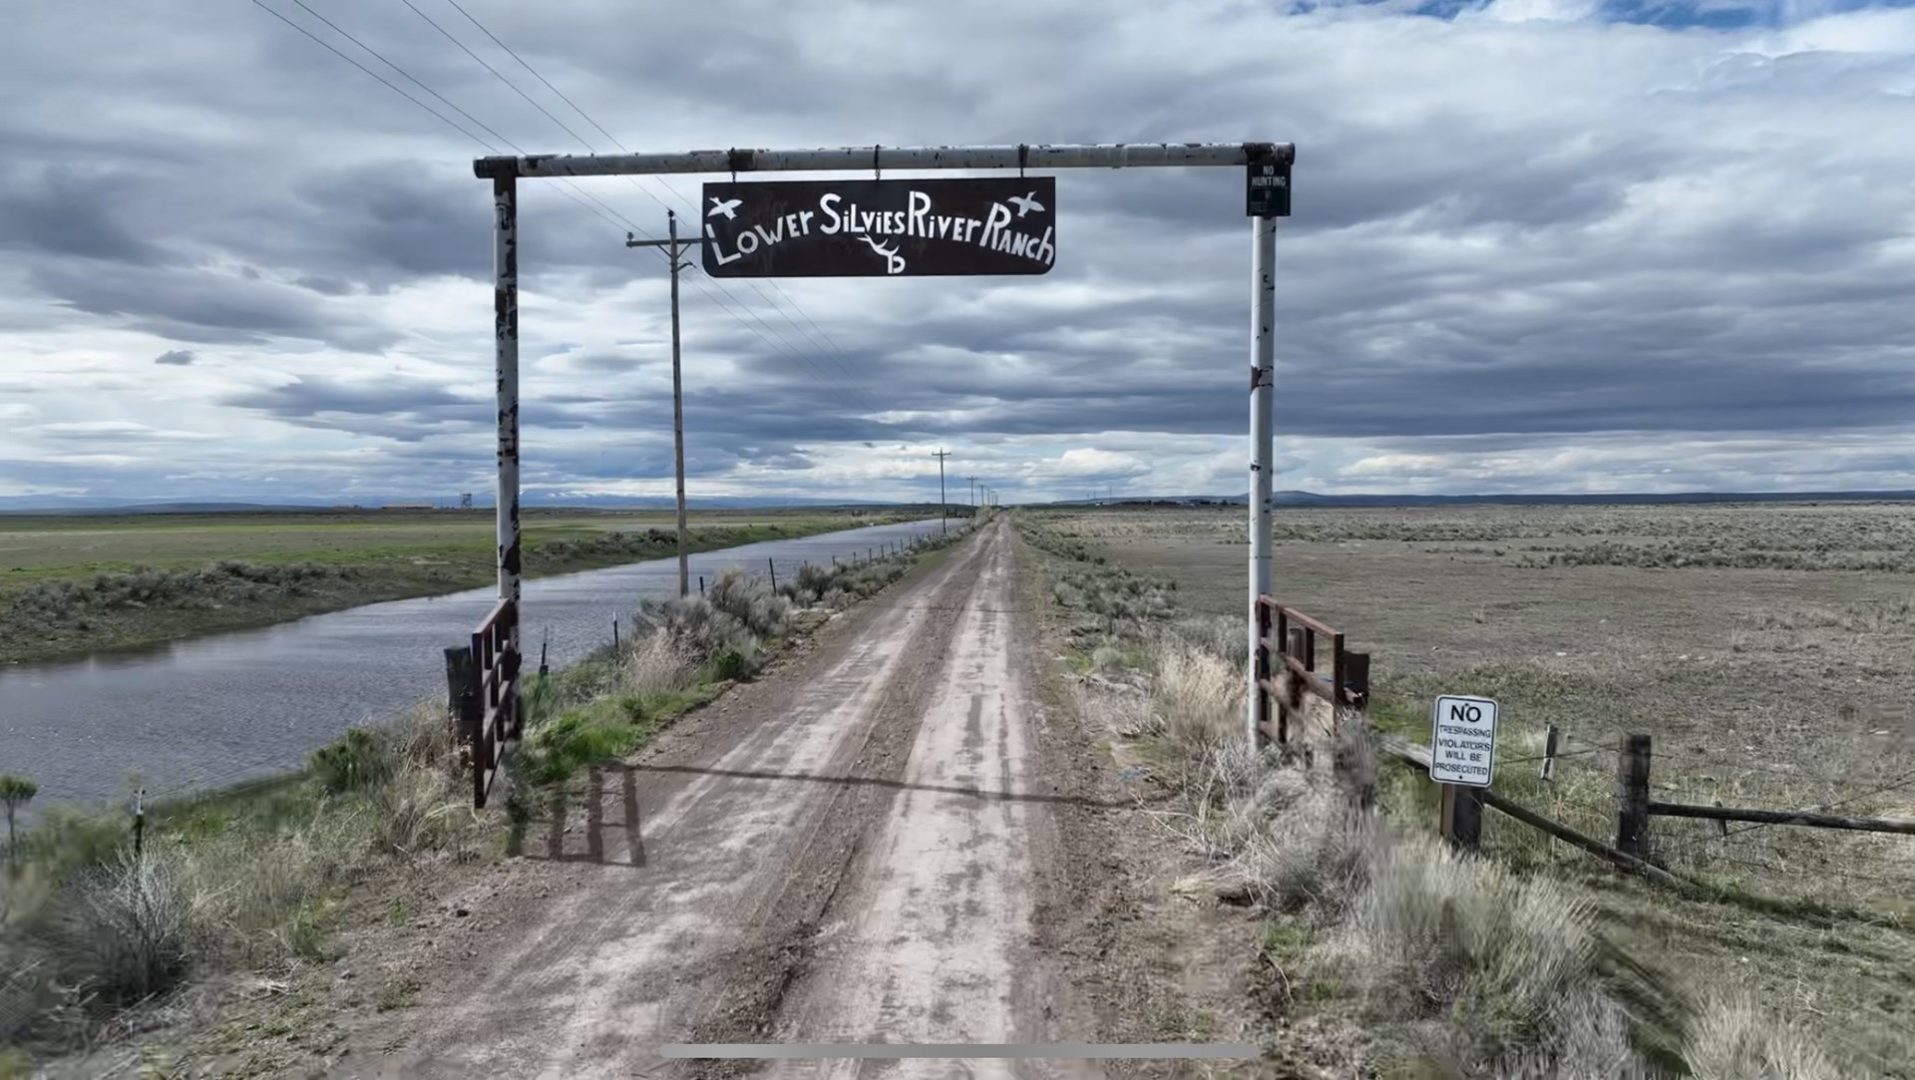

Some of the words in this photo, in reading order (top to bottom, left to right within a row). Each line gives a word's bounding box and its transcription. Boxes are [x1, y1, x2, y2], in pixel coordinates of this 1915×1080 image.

[1263, 165, 1274, 176] NO
[1251, 176, 1286, 187] HUNTING
[1451, 705, 1481, 722] NO
[1440, 725, 1490, 737] TRESPASSING
[1439, 739, 1490, 751] VIOLATORS
[1445, 750, 1466, 761] WILL
[1469, 752, 1482, 762] BE
[1435, 762, 1487, 775] PROSECUTED
